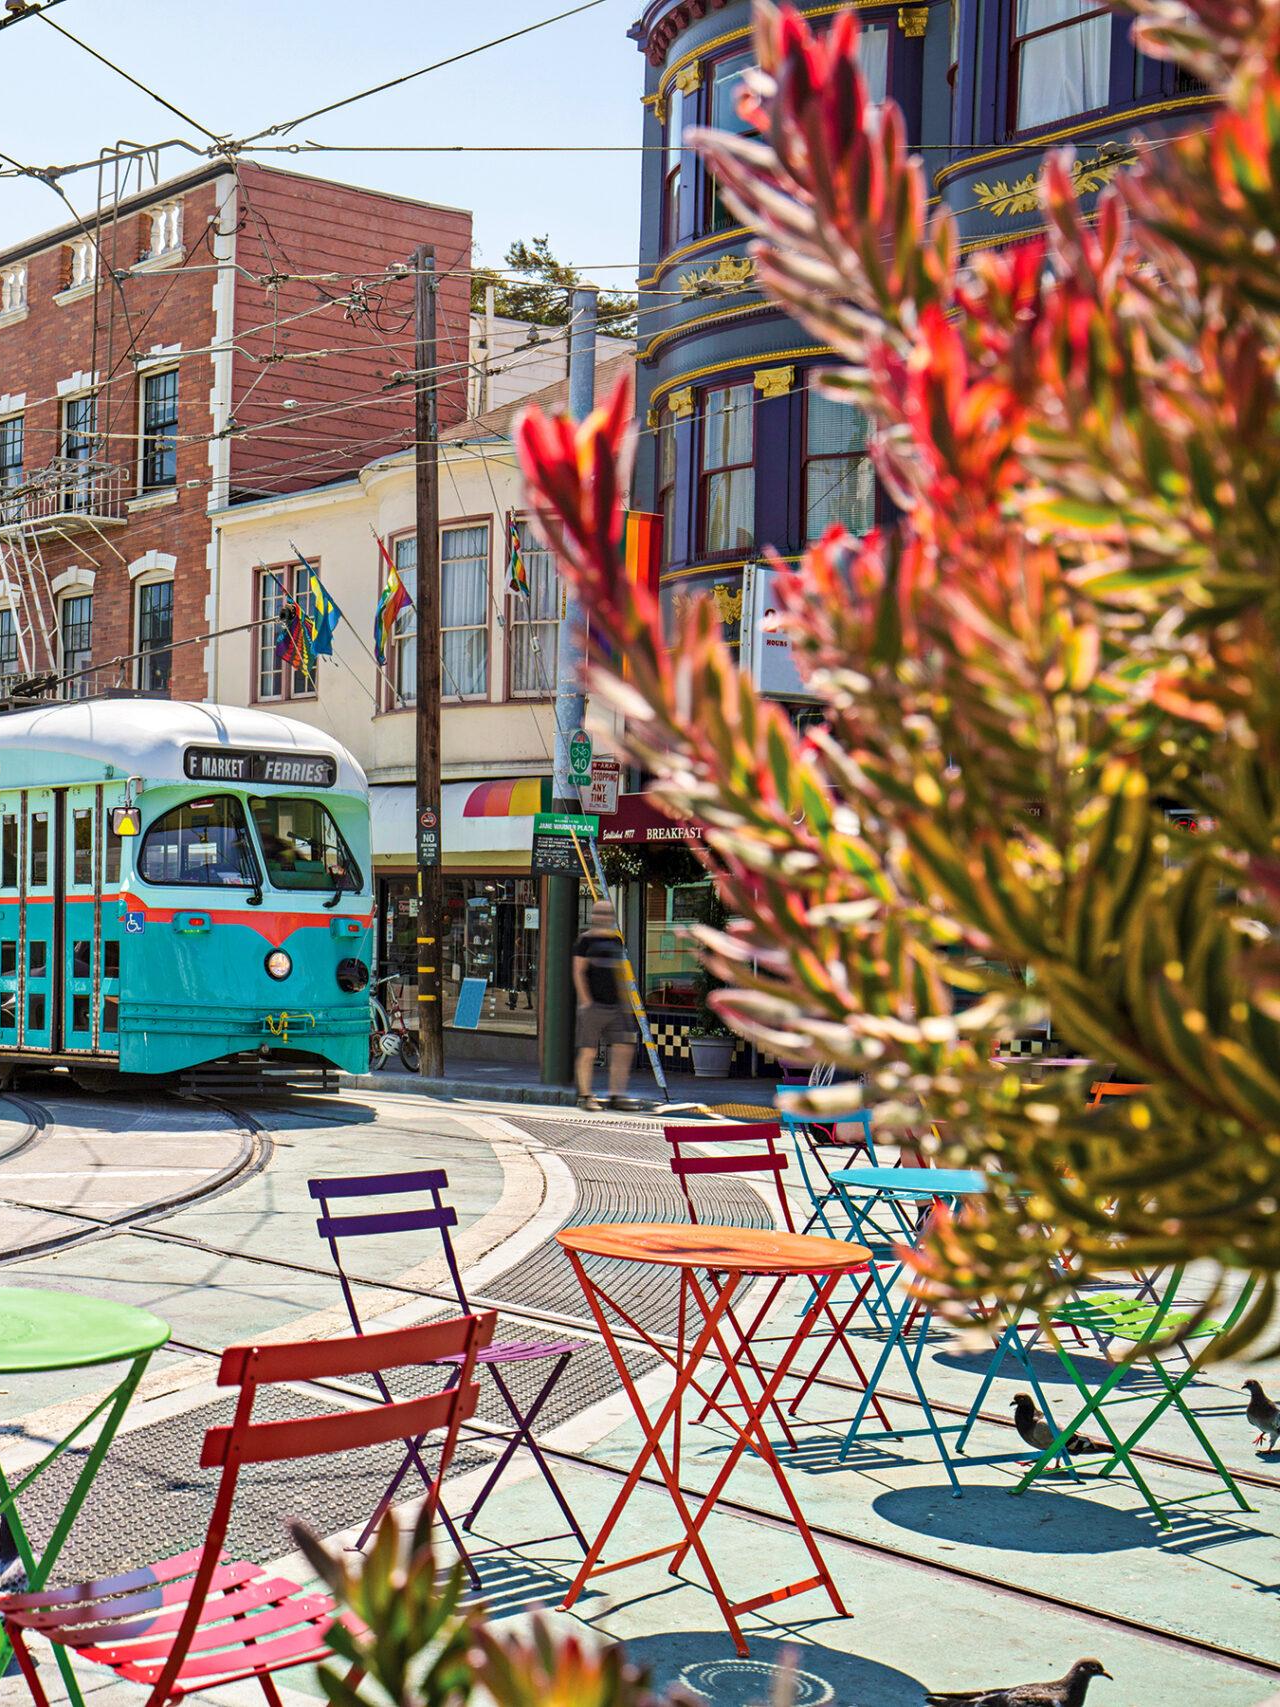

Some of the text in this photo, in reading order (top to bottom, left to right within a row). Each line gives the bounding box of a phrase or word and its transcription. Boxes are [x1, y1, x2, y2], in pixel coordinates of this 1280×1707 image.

[766, 639, 788, 647] HOURS
[189, 756, 244, 778] F MARKET
[573, 758, 587, 770] 40
[264, 761, 323, 782] FERRIES
[592, 783, 607, 792] ANY
[591, 794, 607, 803] TIME
[423, 834, 435, 843] NO
[646, 827, 703, 840] BREAKFAST
